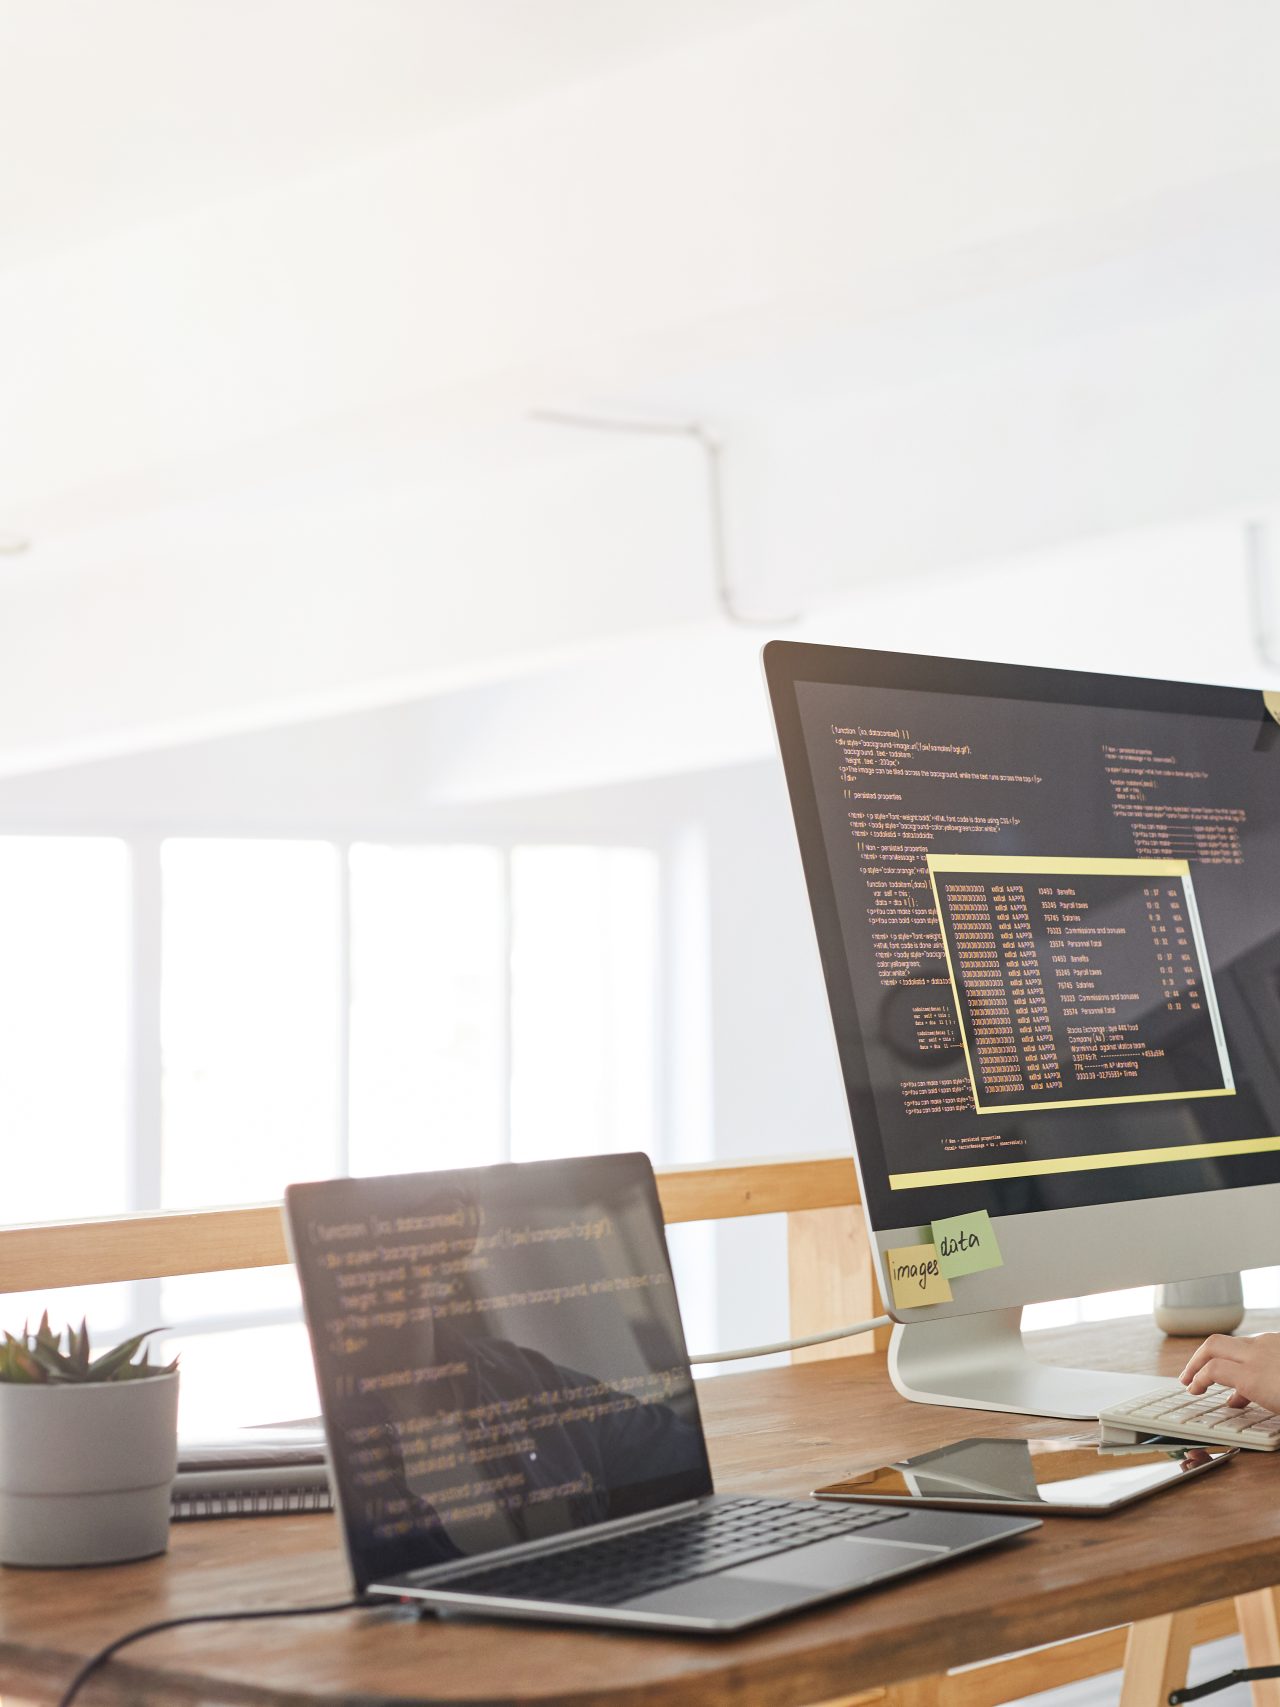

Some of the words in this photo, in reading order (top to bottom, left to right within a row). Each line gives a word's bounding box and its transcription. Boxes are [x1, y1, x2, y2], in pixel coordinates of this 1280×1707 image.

[1110, 993, 1120, 1001] and
[1068, 1035, 1092, 1043] Company
[940, 1230, 980, 1257] data
[892, 1259, 939, 1290] images
